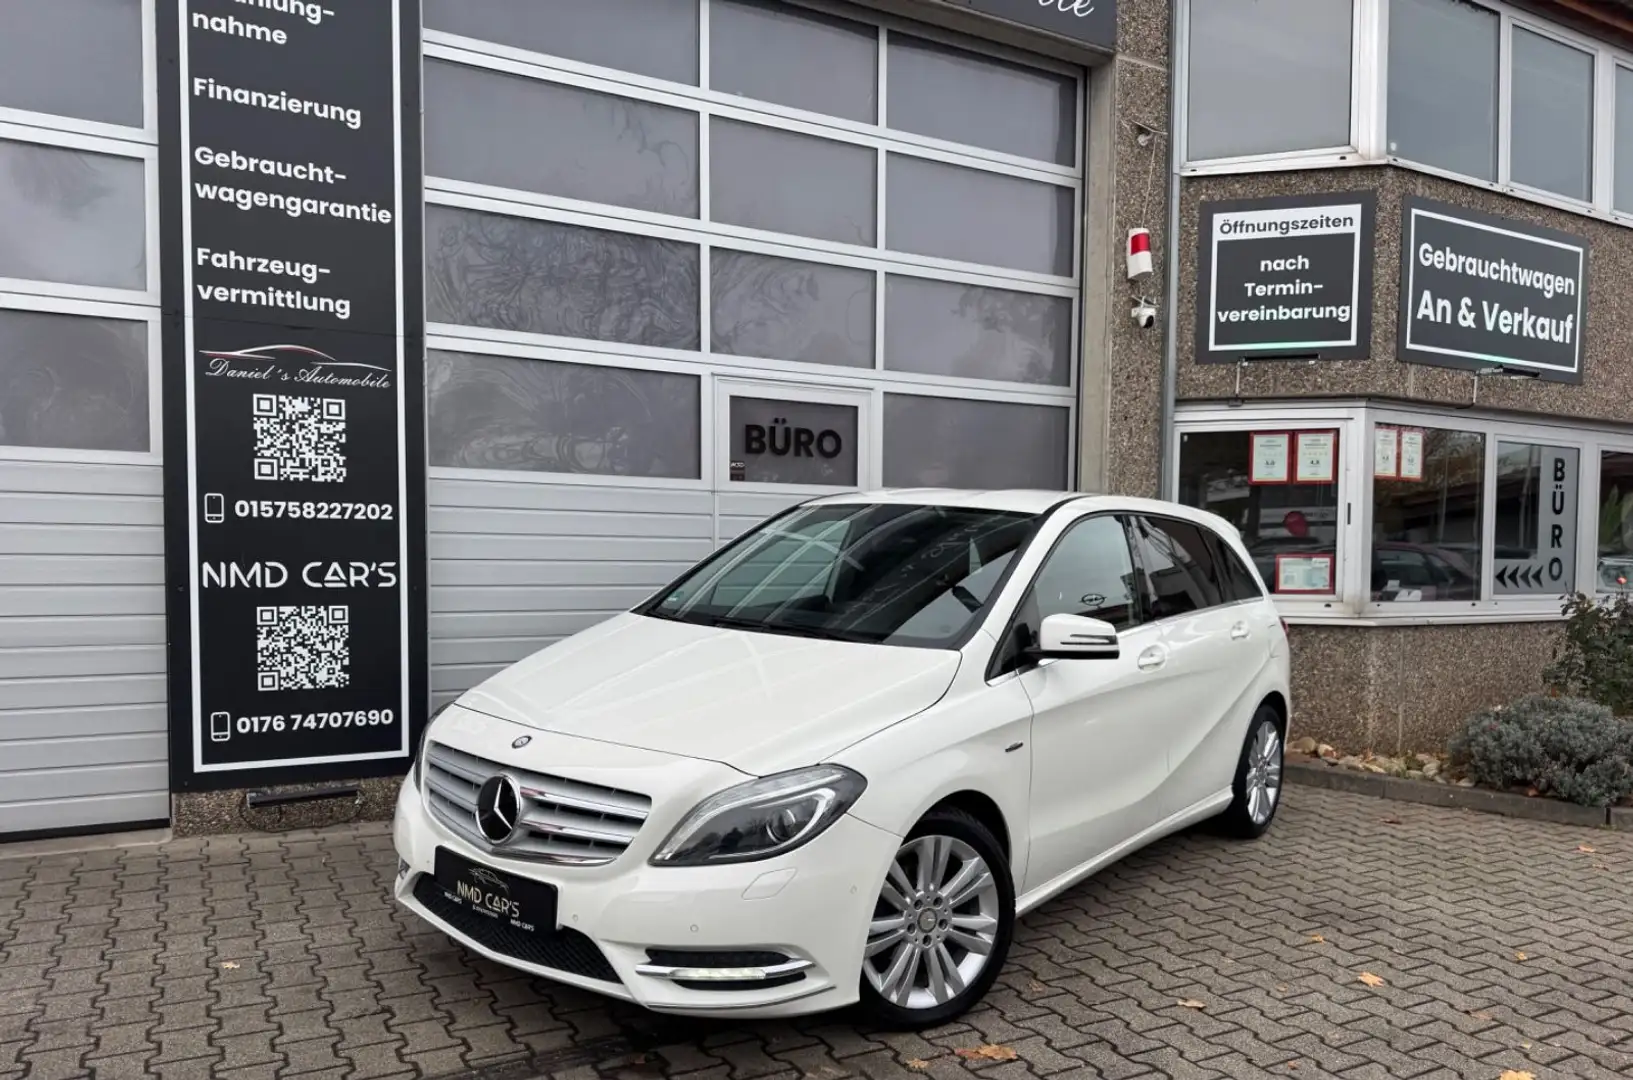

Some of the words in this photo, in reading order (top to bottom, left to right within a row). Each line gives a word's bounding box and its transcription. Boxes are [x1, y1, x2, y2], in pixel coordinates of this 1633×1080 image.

[193, 12, 288, 45] nahme
[193, 77, 362, 130] Finanzierung
[194, 146, 347, 184] Gebraucht-
[194, 182, 392, 224] wagengarantie
[1219, 214, 1354, 236] Öffnungszeiten
[196, 247, 331, 284] Fahrzeug-
[1260, 255, 1310, 272] nach
[1418, 242, 1576, 299] Gebrauchtwagen
[196, 283, 351, 320] vermittlung
[1243, 278, 1324, 298] Termin-
[1216, 304, 1351, 323] vereinbarung
[1416, 289, 1453, 325] An
[1457, 296, 1477, 329] &
[1481, 300, 1574, 345] Verkauf
[294, 366, 392, 388] Automobile
[744, 417, 843, 460] BÜRO
[234, 499, 394, 521] 015758227202
[1548, 457, 1566, 581] BÜRO
[202, 561, 288, 588] NMD
[301, 561, 397, 588] CAR'S
[236, 714, 286, 734] 0176
[290, 708, 394, 731] 74707690
[457, 880, 482, 903] NMD
[485, 893, 520, 917] CAR'S
